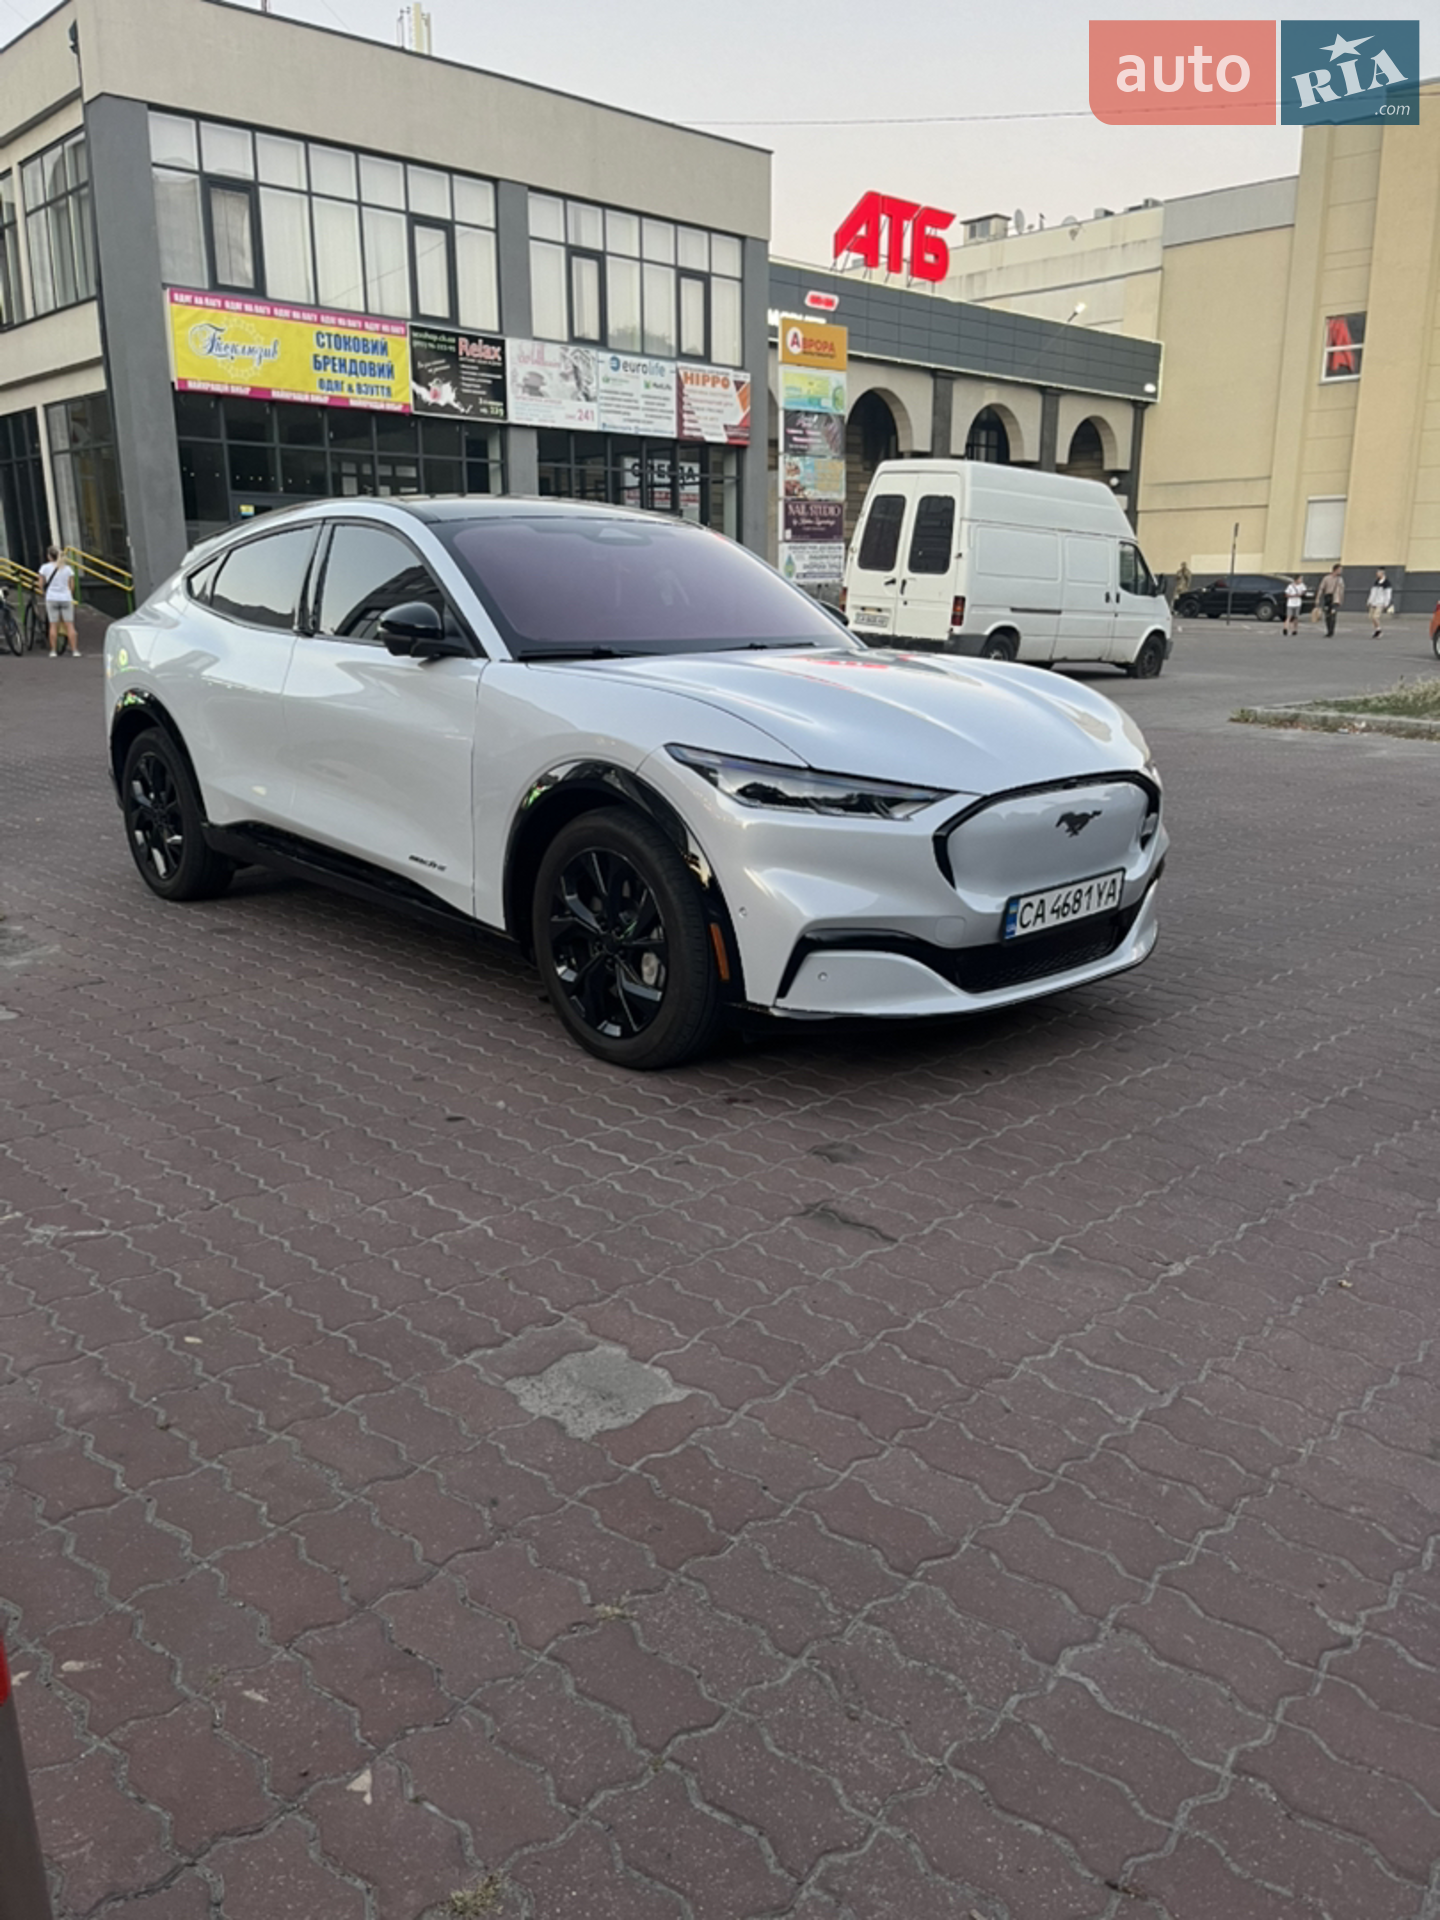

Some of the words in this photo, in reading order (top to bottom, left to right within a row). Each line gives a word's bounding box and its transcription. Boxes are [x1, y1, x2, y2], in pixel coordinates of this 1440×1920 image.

[834, 191, 957, 281] АТБ
[315, 330, 388, 357] СТОКОВИЙ
[458, 337, 502, 361] Relax
[312, 354, 395, 380] БРЕНДОВИЙ
[622, 360, 666, 377] eurolife
[356, 382, 392, 398] ВЗУТТЯ
[683, 371, 730, 389] HIPPO
[577, 408, 594, 422] 241
[1019, 898, 1046, 929] CA
[1050, 885, 1093, 920] 4681
[1097, 878, 1117, 908] YA
